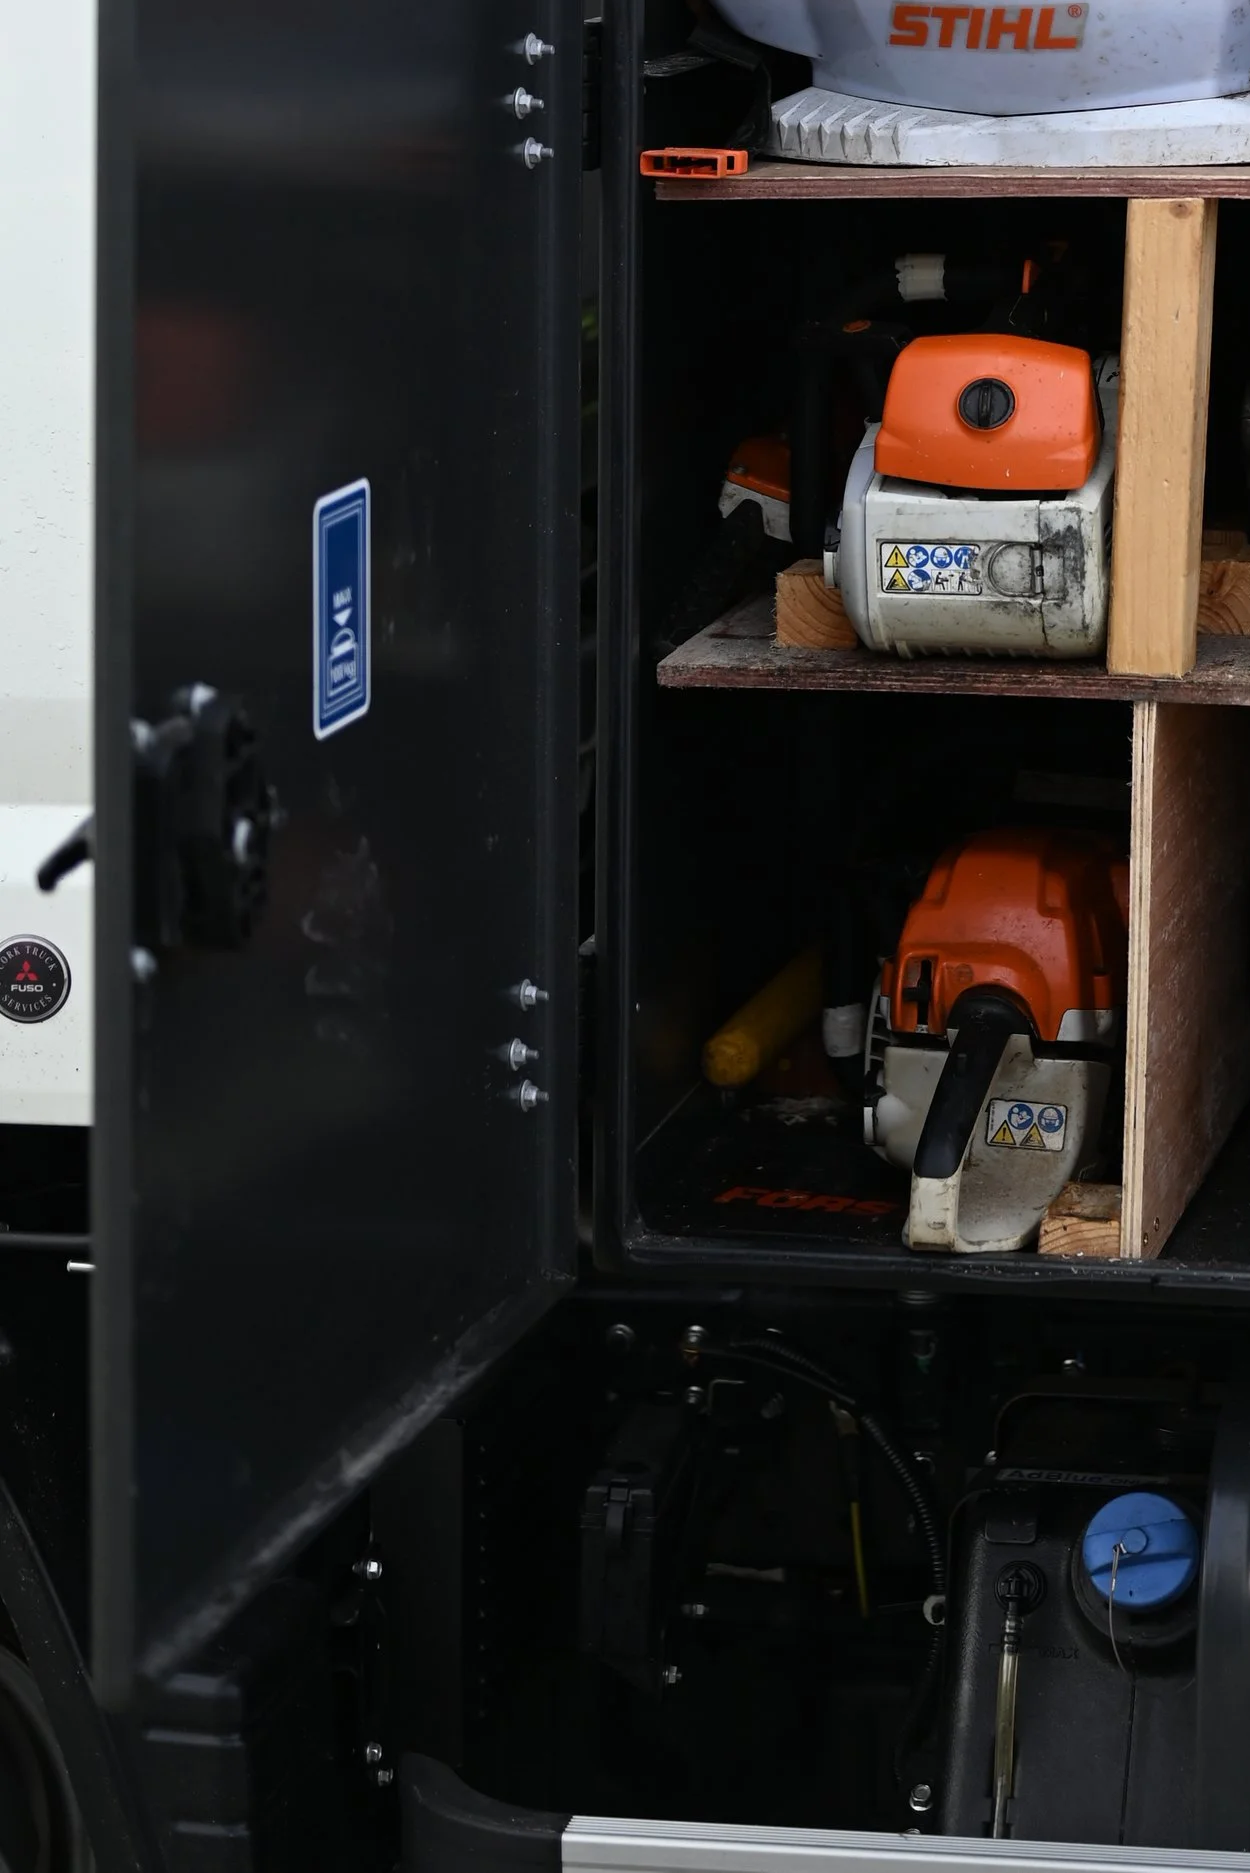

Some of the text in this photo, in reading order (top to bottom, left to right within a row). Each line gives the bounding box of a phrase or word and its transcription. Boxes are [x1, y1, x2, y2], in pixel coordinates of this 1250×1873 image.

[25, 945, 58, 972] TRUCK
[10, 984, 44, 993] FUSO
[2, 994, 52, 1013] SERVICES
